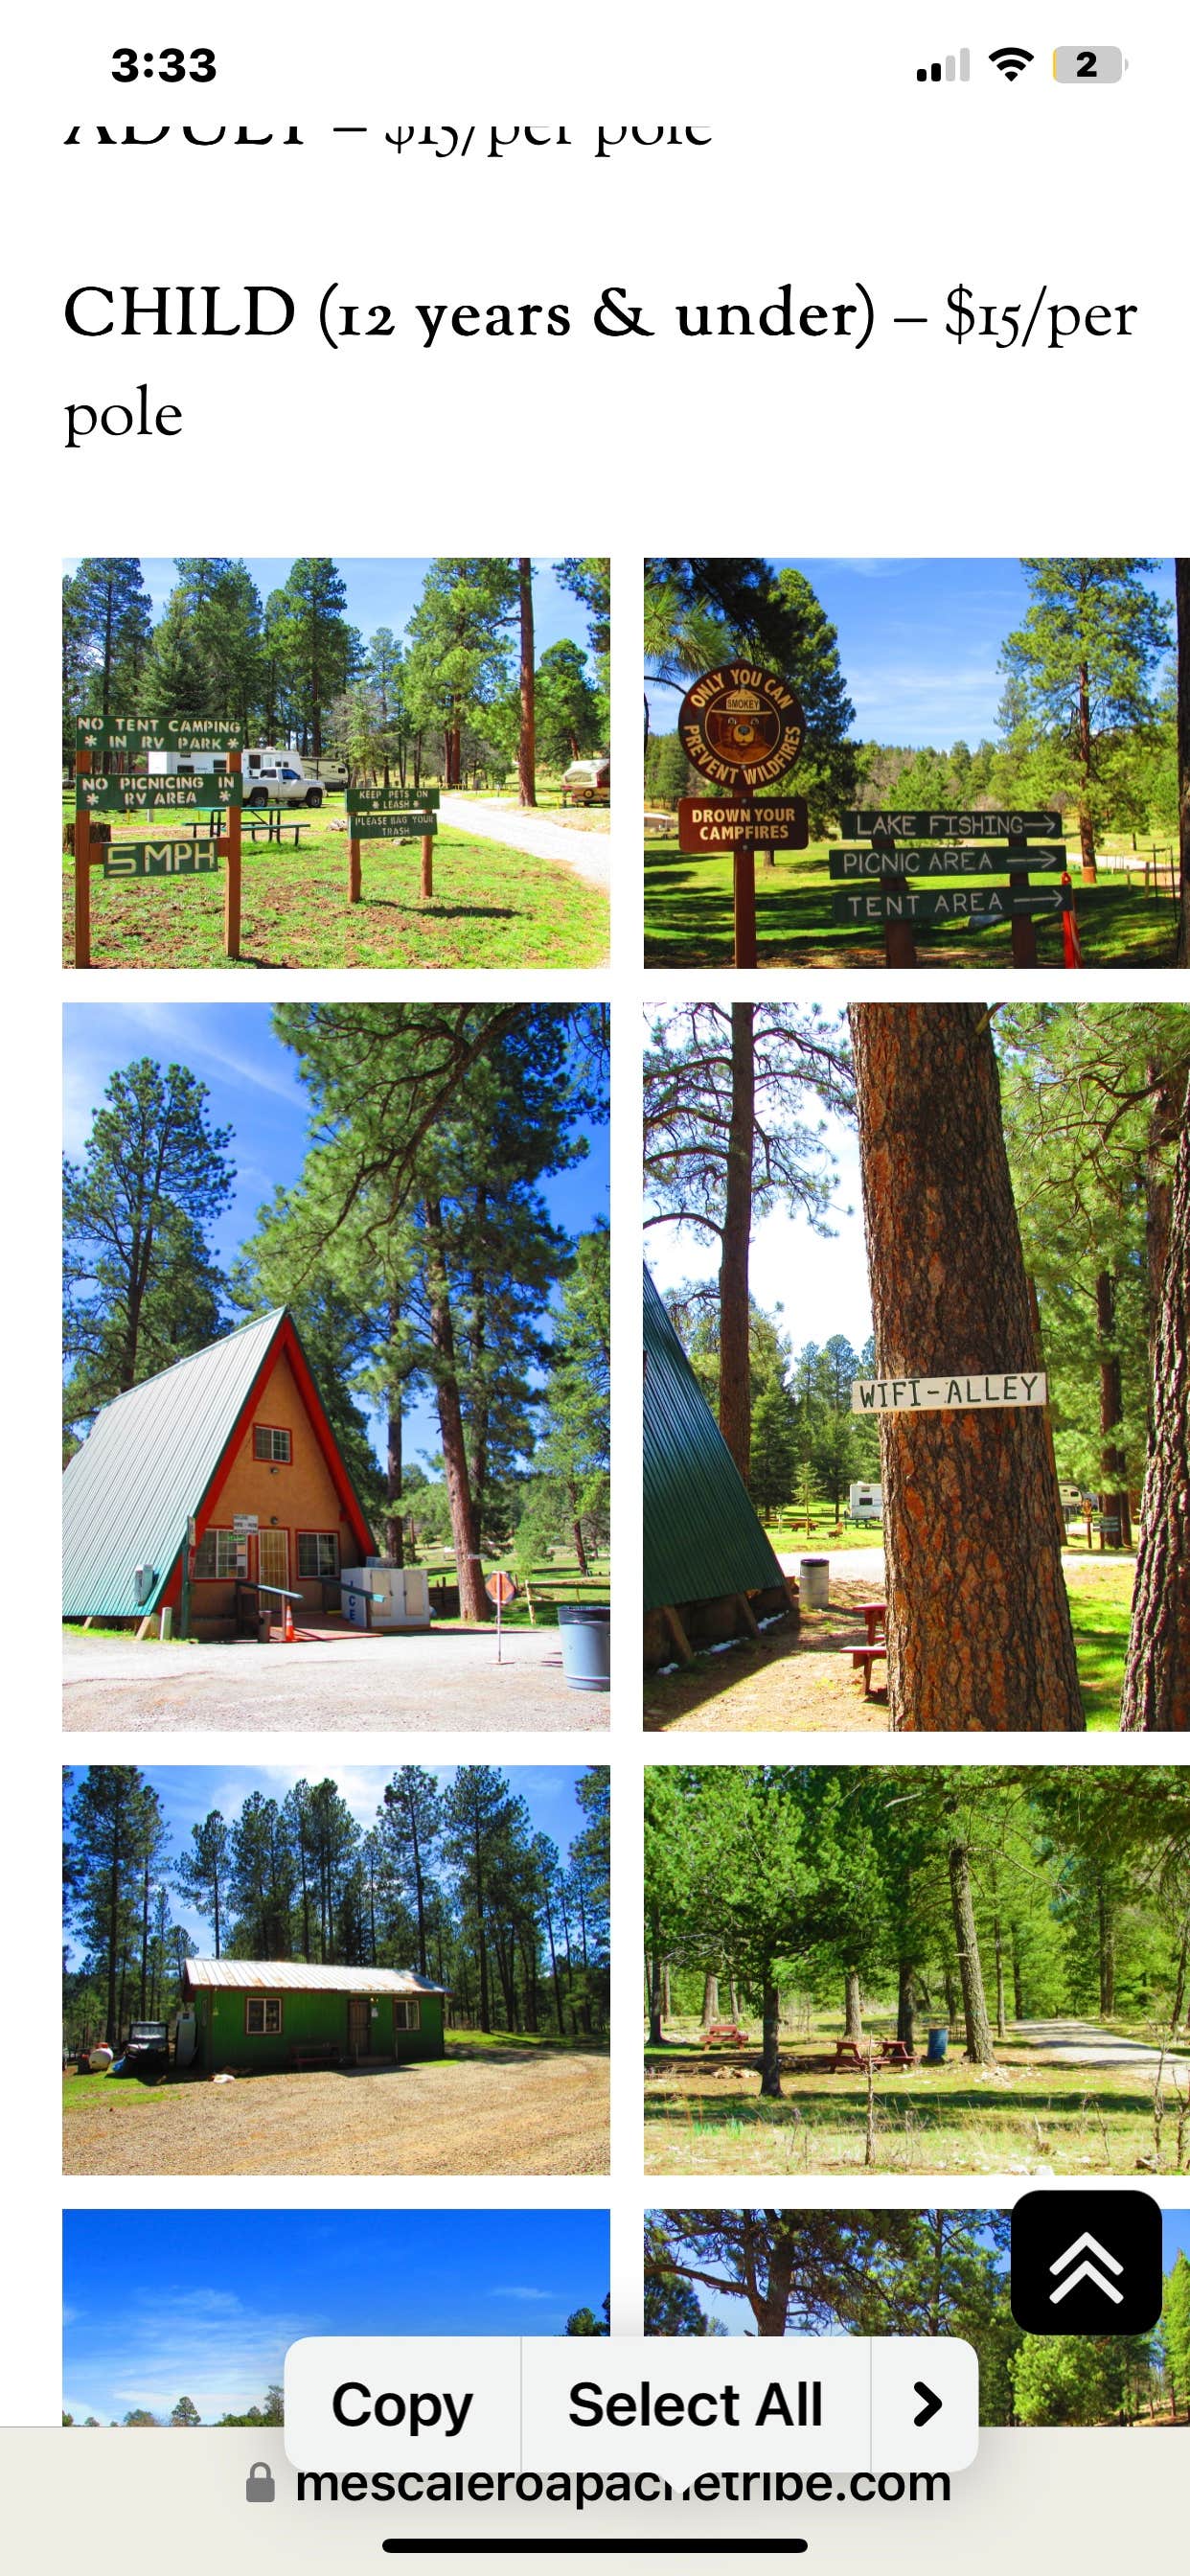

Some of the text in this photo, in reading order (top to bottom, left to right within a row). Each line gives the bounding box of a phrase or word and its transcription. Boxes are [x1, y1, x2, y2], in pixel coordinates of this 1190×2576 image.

[112, 48, 217, 83] 3:33
[1076, 51, 1098, 78] 2
[64, 286, 295, 337] CHILD
[415, 304, 571, 349] years
[593, 287, 655, 337] &
[675, 282, 875, 350] under)
[945, 283, 1138, 349] $15/per
[63, 382, 182, 448] pole
[690, 669, 794, 709] ONLY YOU CAN
[727, 699, 760, 709] SMOKEY
[78, 717, 241, 733] NO TENT CAMPING
[109, 735, 221, 749] IN RV PARK
[683, 724, 801, 785] PREVENT WILDFIRES
[82, 776, 235, 791] NO PICNICING IN
[125, 791, 197, 805] RV AREA
[359, 790, 381, 799] KEEP
[388, 790, 410, 798] PETS
[383, 800, 410, 809] LEASH
[355, 816, 388, 826] PLEASE
[412, 815, 434, 824] YOUR
[692, 808, 795, 823] DROWN YOUR
[857, 815, 1024, 836] LAKE FISHING
[382, 827, 410, 836] TRASH
[699, 825, 790, 840] CAMPFIRES
[843, 851, 993, 875] PICNIC AREA
[847, 892, 1003, 917] TENT AREA
[859, 1375, 1039, 1409] WIFI-ALLEY
[332, 2381, 474, 2437] Copy
[568, 2380, 822, 2427] Select All
